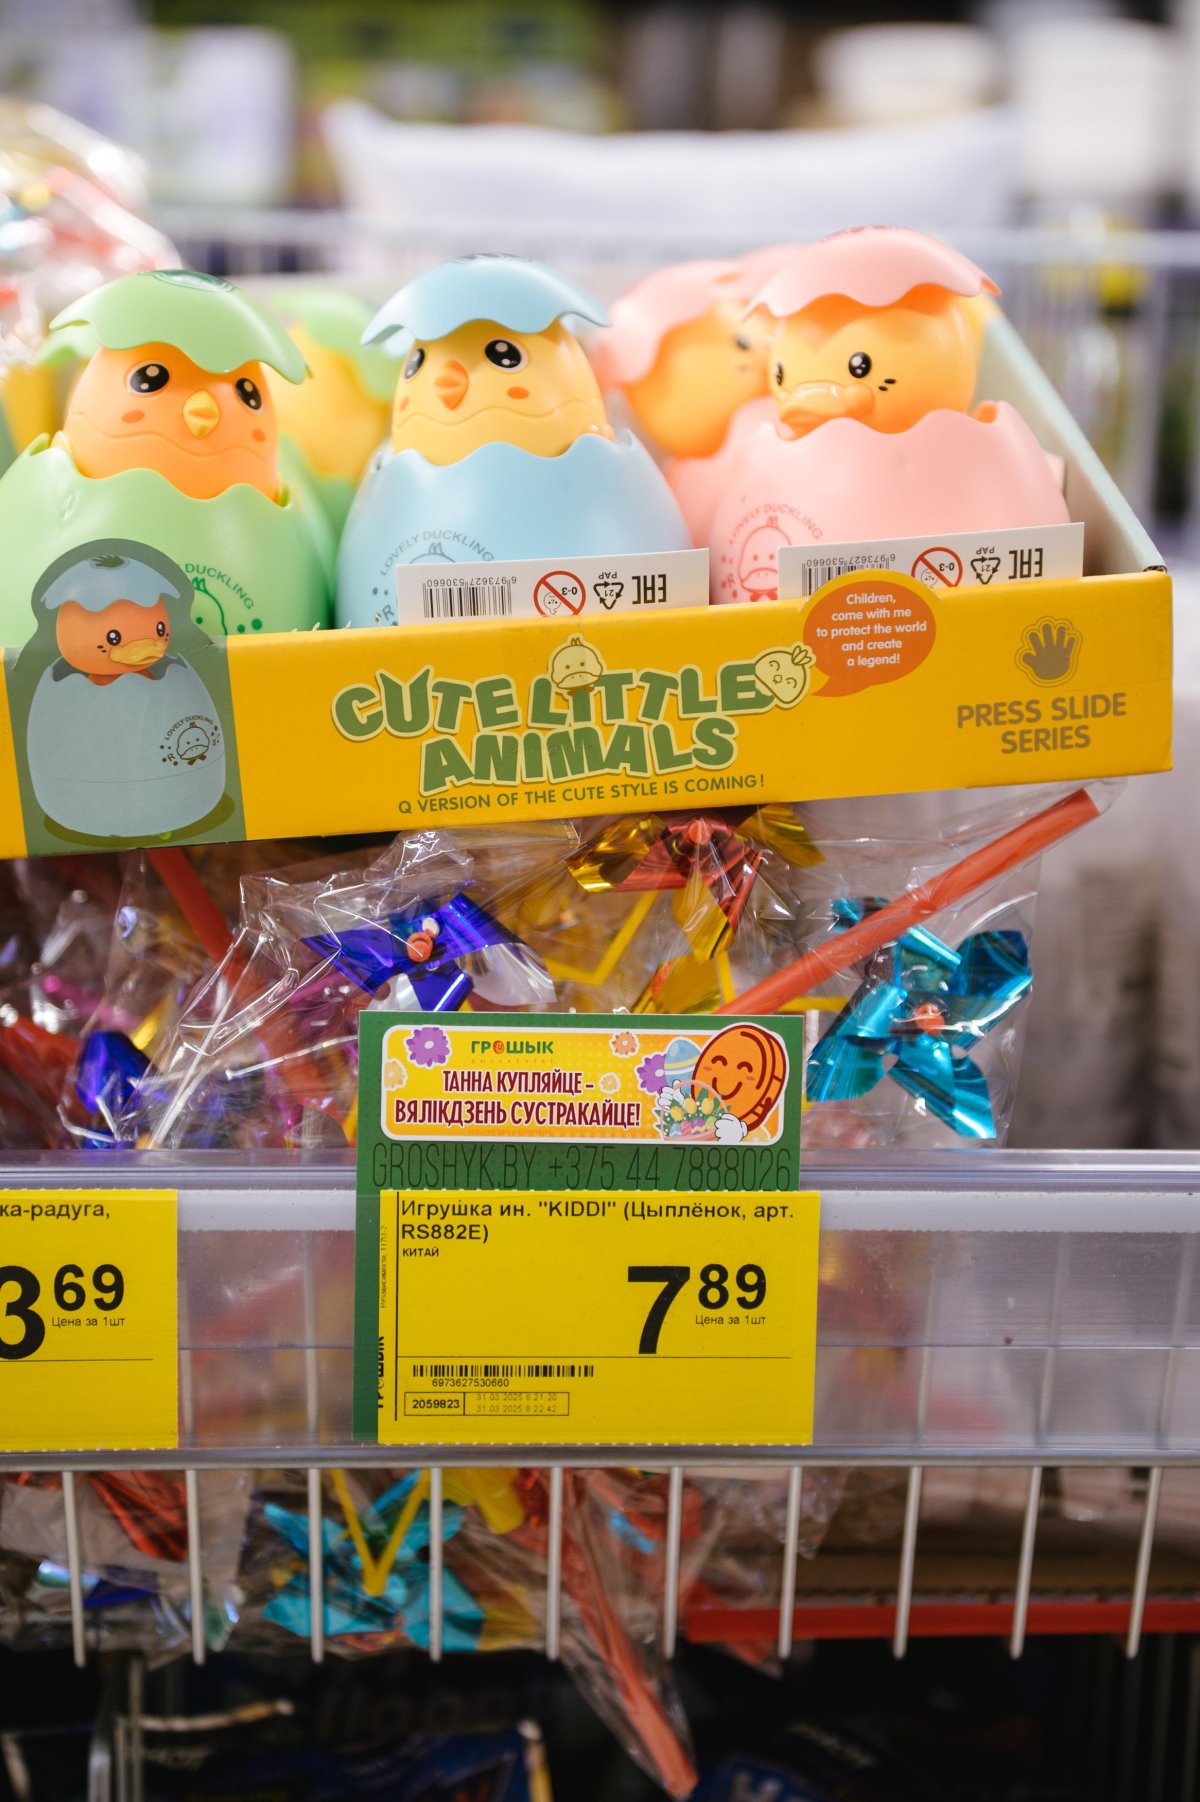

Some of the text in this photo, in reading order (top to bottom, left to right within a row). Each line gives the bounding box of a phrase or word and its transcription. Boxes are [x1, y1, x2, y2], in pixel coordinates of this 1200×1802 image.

[423, 530, 495, 562] DUCKLING
[975, 546, 996, 555] PAP
[598, 572, 618, 580] PAP
[938, 562, 956, 573] 0-3
[185, 563, 254, 610] DUCKLING
[561, 586, 578, 597] 0-3
[846, 593, 897, 604] Children,
[832, 608, 912, 622] come with me
[816, 620, 927, 640] to protect the world
[842, 639, 903, 652] and create
[847, 653, 900, 668] a legend!
[333, 662, 776, 740] CUTE LITTLE
[957, 692, 1127, 729] PRESS SLIDE
[1001, 725, 1091, 755] SERIES
[420, 716, 739, 796] ANIMALS
[398, 774, 765, 814] Q VERSION OF THE CUTE STYLE IS COMING!
[471, 1040, 554, 1056] ГРОШЫК
[442, 1070, 493, 1093] ТАННА
[497, 1070, 582, 1096] КУПЛЯЙЦЕ
[395, 1099, 641, 1127] ВЯЛІКДЗЕНЬ СУСТРАКАЙЦЕ!
[372, 1143, 791, 1191] GROSHYK.BY +375 44 7888026
[402, 1200, 794, 1222] Игрушка ин. "KIDDI" (Цыплёнок, арт.
[401, 1223, 489, 1244] RS882E)
[402, 1246, 440, 1257] КИТАЙ
[0, 1263, 125, 1360] 3 69
[627, 1263, 767, 1355] 7 89
[51, 1317, 125, 1328] Цена за 1шт
[695, 1314, 767, 1328] Цена за 1шт
[431, 1378, 510, 1388] 6973627530660
[411, 1399, 461, 1410] 2059823
